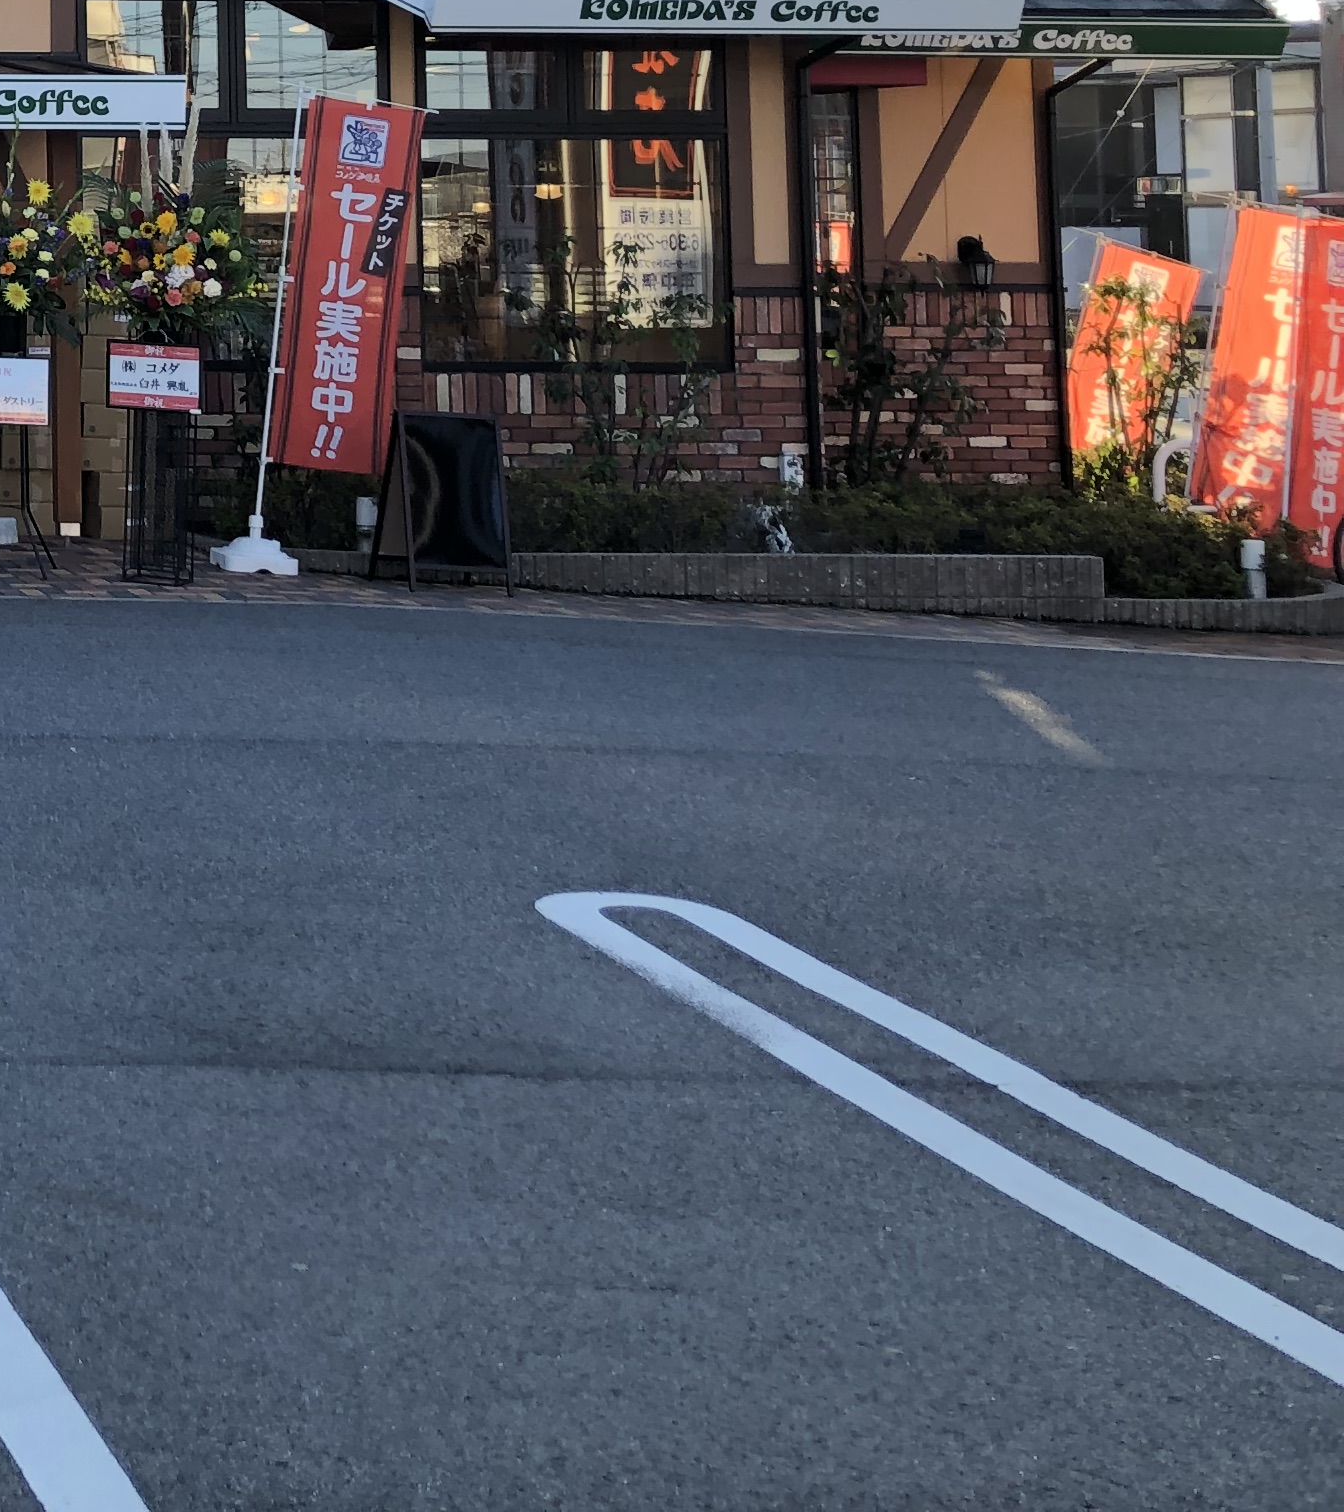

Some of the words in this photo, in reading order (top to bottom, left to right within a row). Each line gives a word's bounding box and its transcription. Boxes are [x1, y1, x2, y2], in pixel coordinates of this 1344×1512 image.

[770, 0, 880, 23] Coffee
[1033, 29, 1133, 51] Coffee
[368, 193, 408, 272] チケット
[310, 184, 375, 460] セール実施中!!
[146, 362, 180, 375] コメダ
